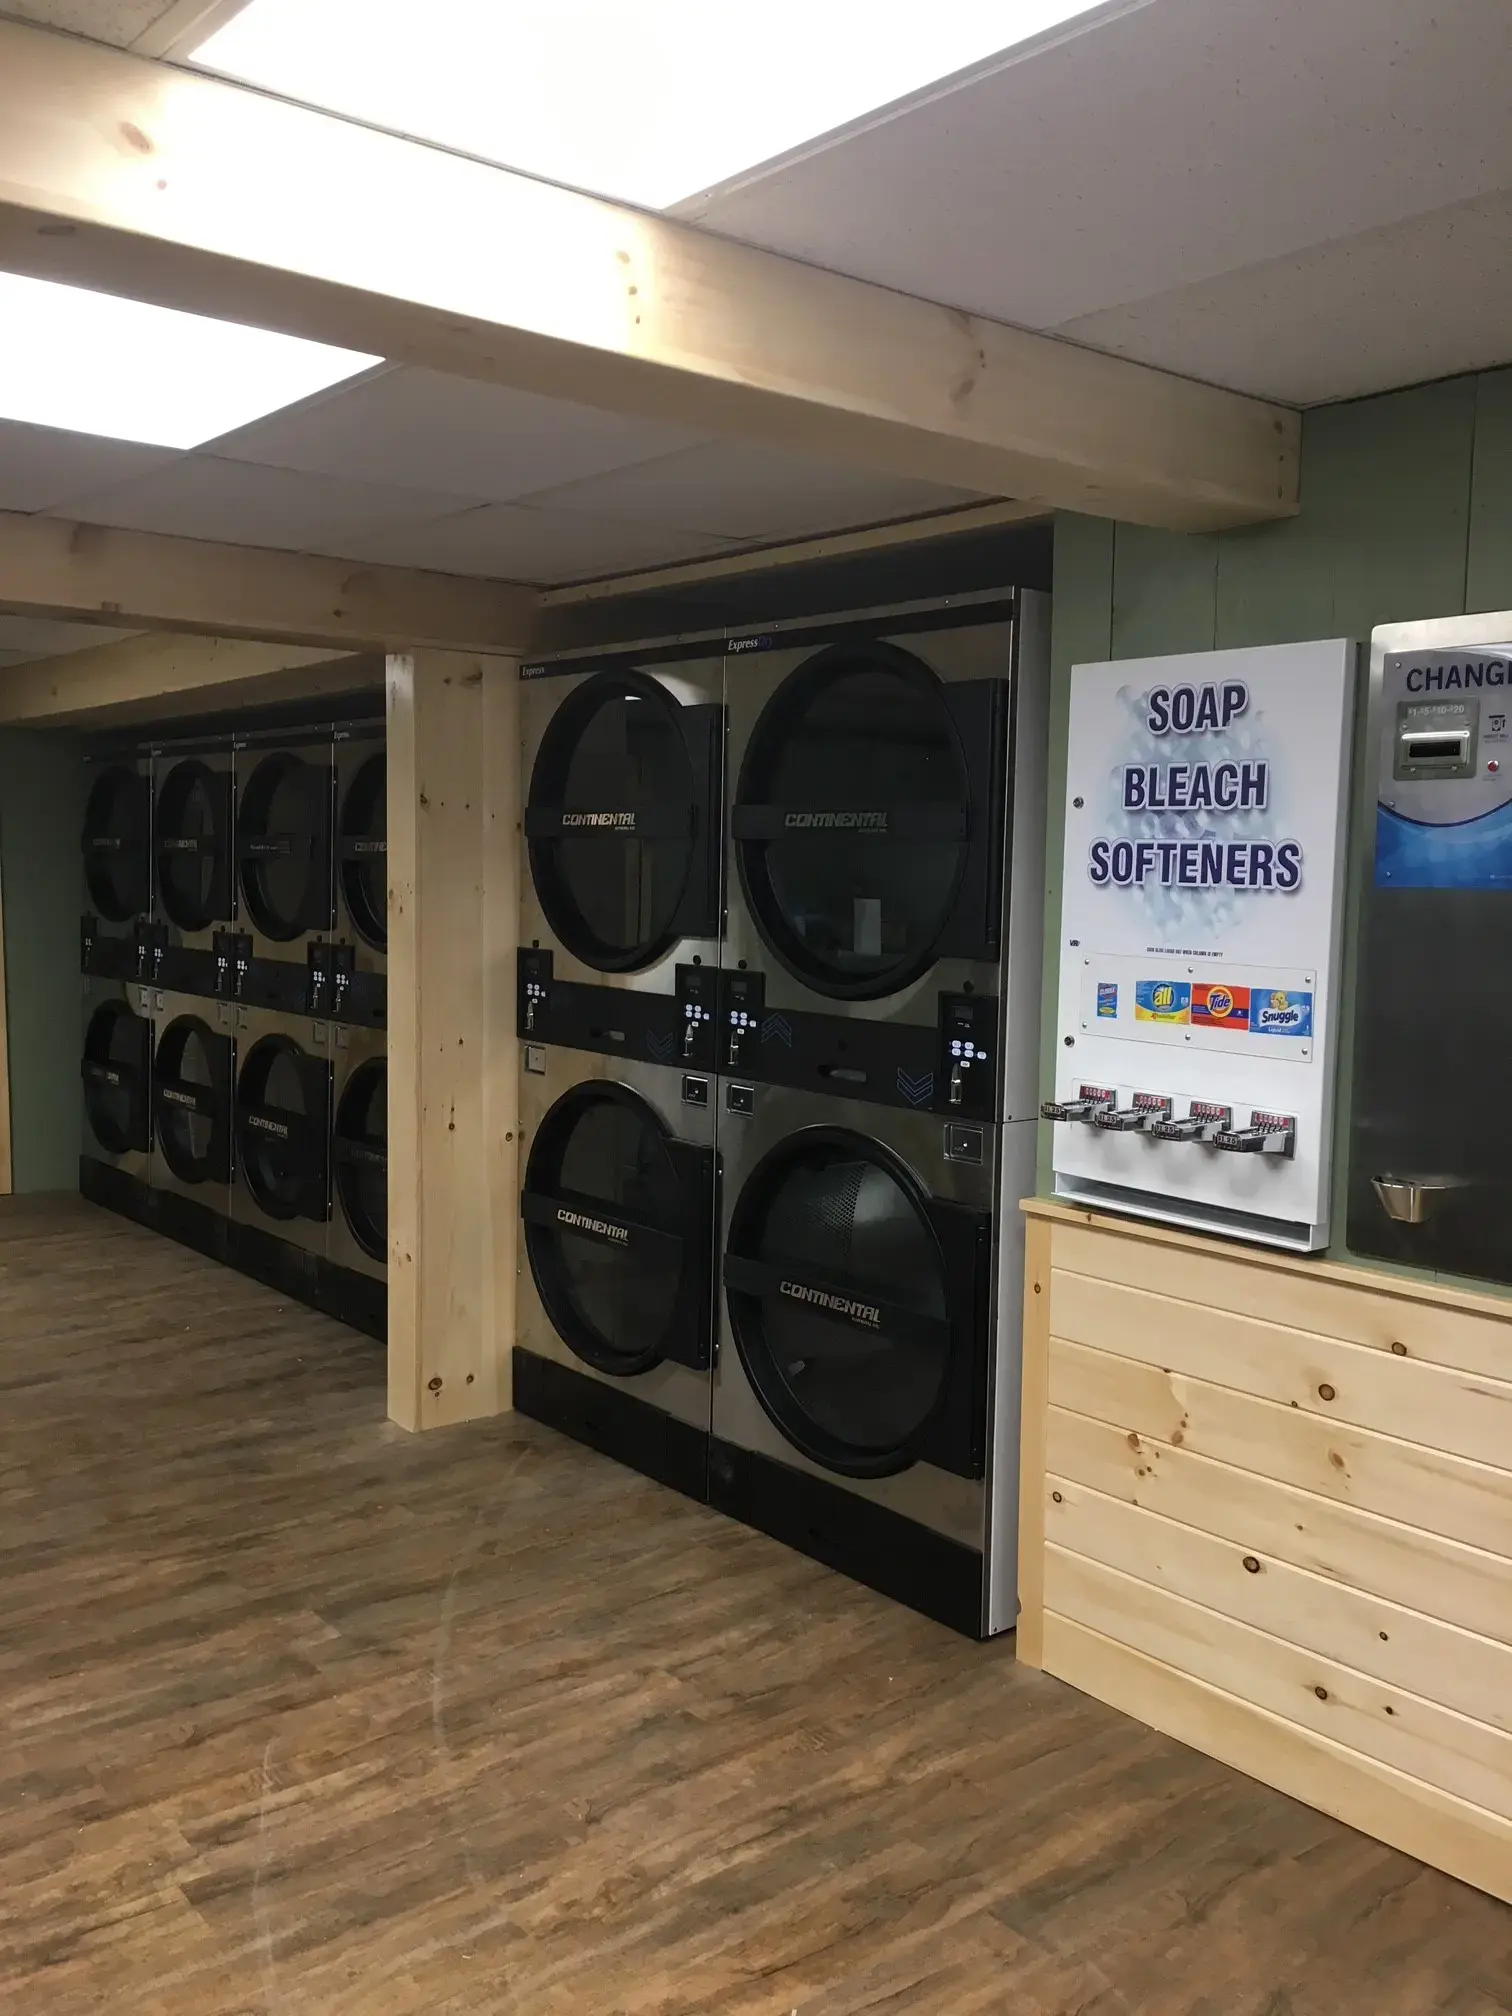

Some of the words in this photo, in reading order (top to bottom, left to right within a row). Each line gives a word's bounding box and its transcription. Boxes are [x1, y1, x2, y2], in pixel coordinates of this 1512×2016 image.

[522, 666, 545, 677] Express
[1407, 661, 1512, 692] CHANG
[1148, 681, 1249, 735] SOAP
[1123, 760, 1268, 810] BLEACH
[562, 813, 636, 826] CONTINENTAL
[785, 812, 888, 828] CONTINENTAL
[1088, 839, 1303, 891] SOFTENERS
[1154, 986, 1173, 1006] all
[1209, 994, 1231, 1011] Tide
[1262, 1010, 1299, 1024] Snuggle
[557, 1208, 629, 1242] CONTINENTAL
[779, 1280, 881, 1323] CONTINENTAL
